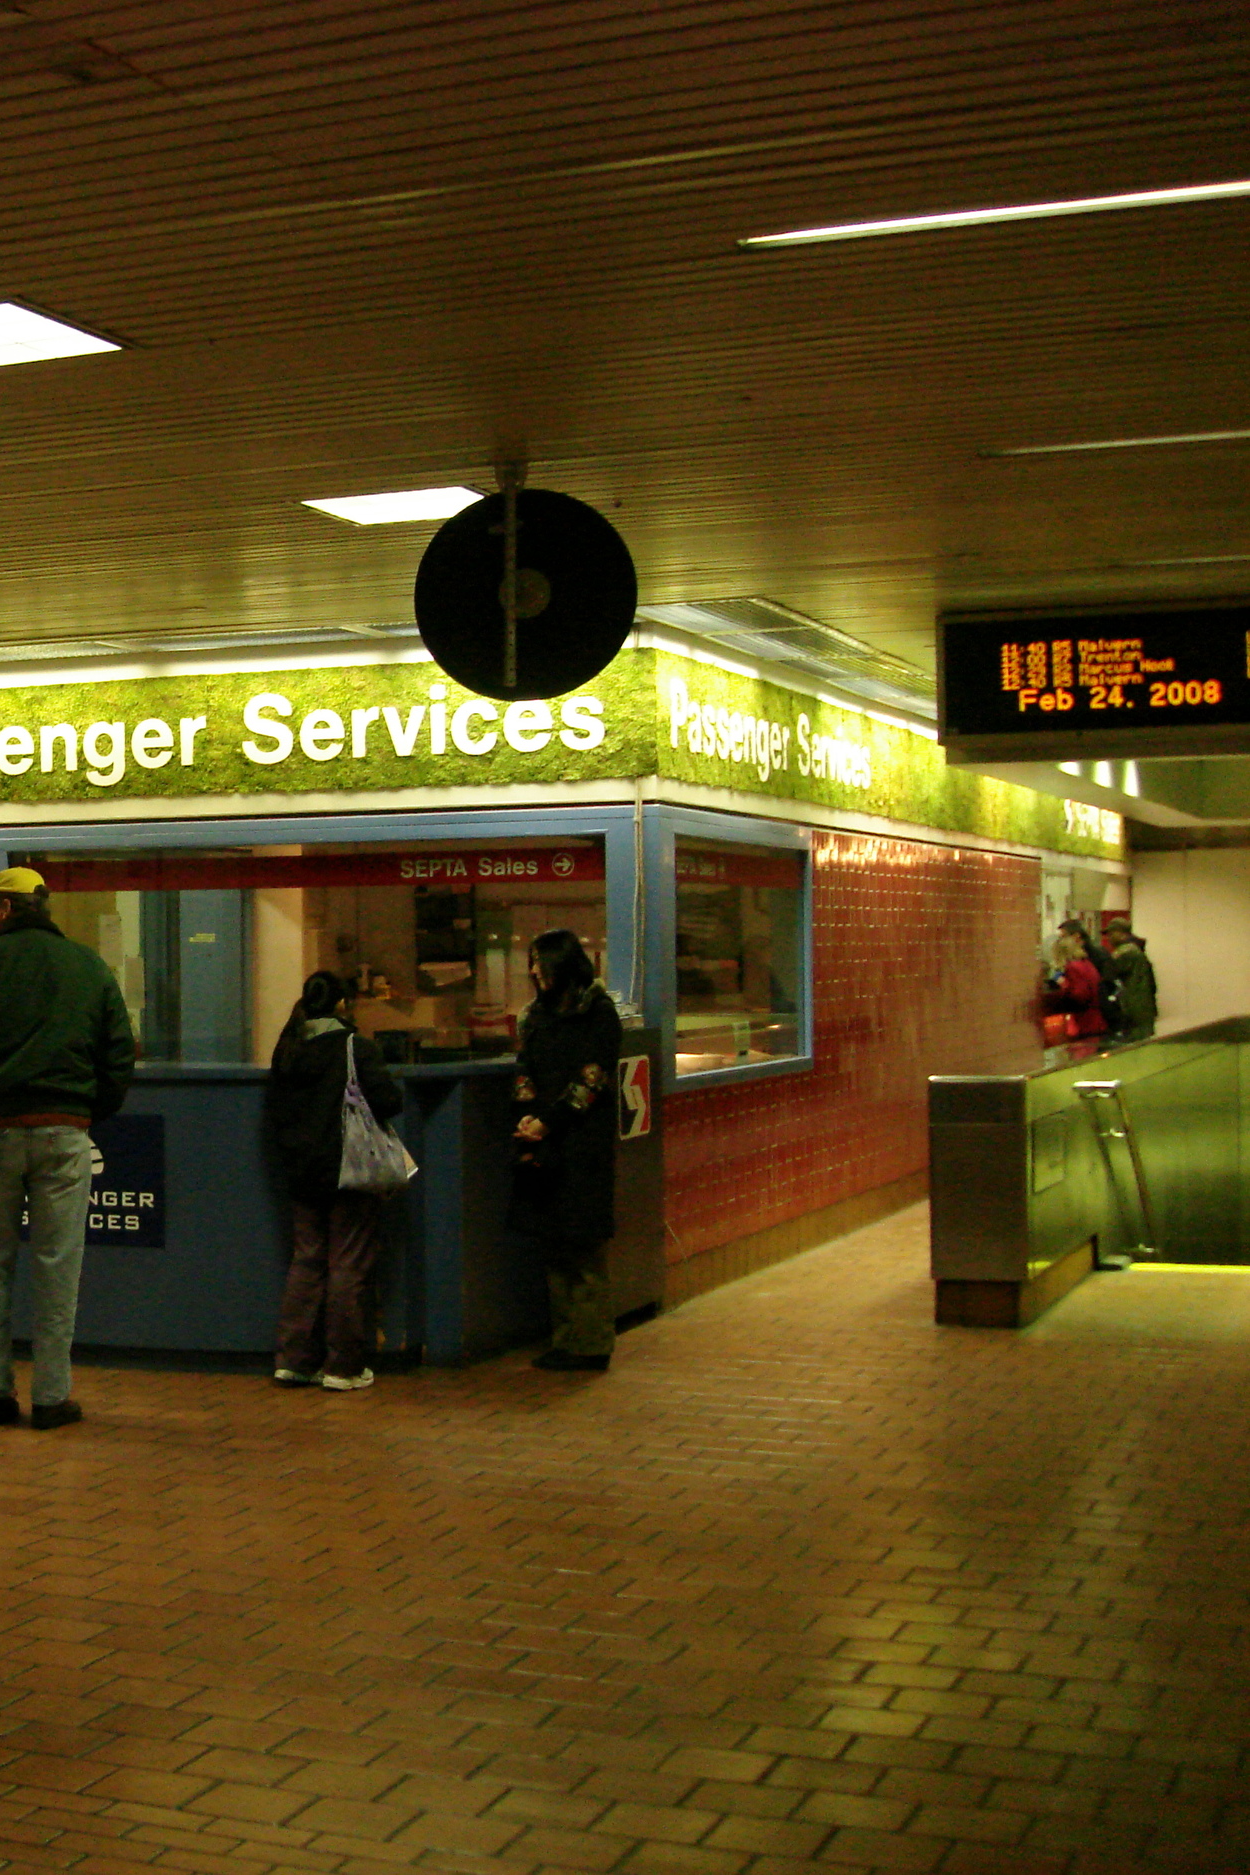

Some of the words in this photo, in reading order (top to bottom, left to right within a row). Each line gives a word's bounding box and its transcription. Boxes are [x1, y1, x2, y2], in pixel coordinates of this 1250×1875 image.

[1018, 687, 1074, 712] Feb
[1149, 679, 1222, 707] 2008
[241, 684, 606, 765] Services
[669, 677, 790, 782] Passenger
[797, 712, 872, 790] Services
[400, 858, 468, 878] SEPTA
[478, 857, 538, 877] Sales
